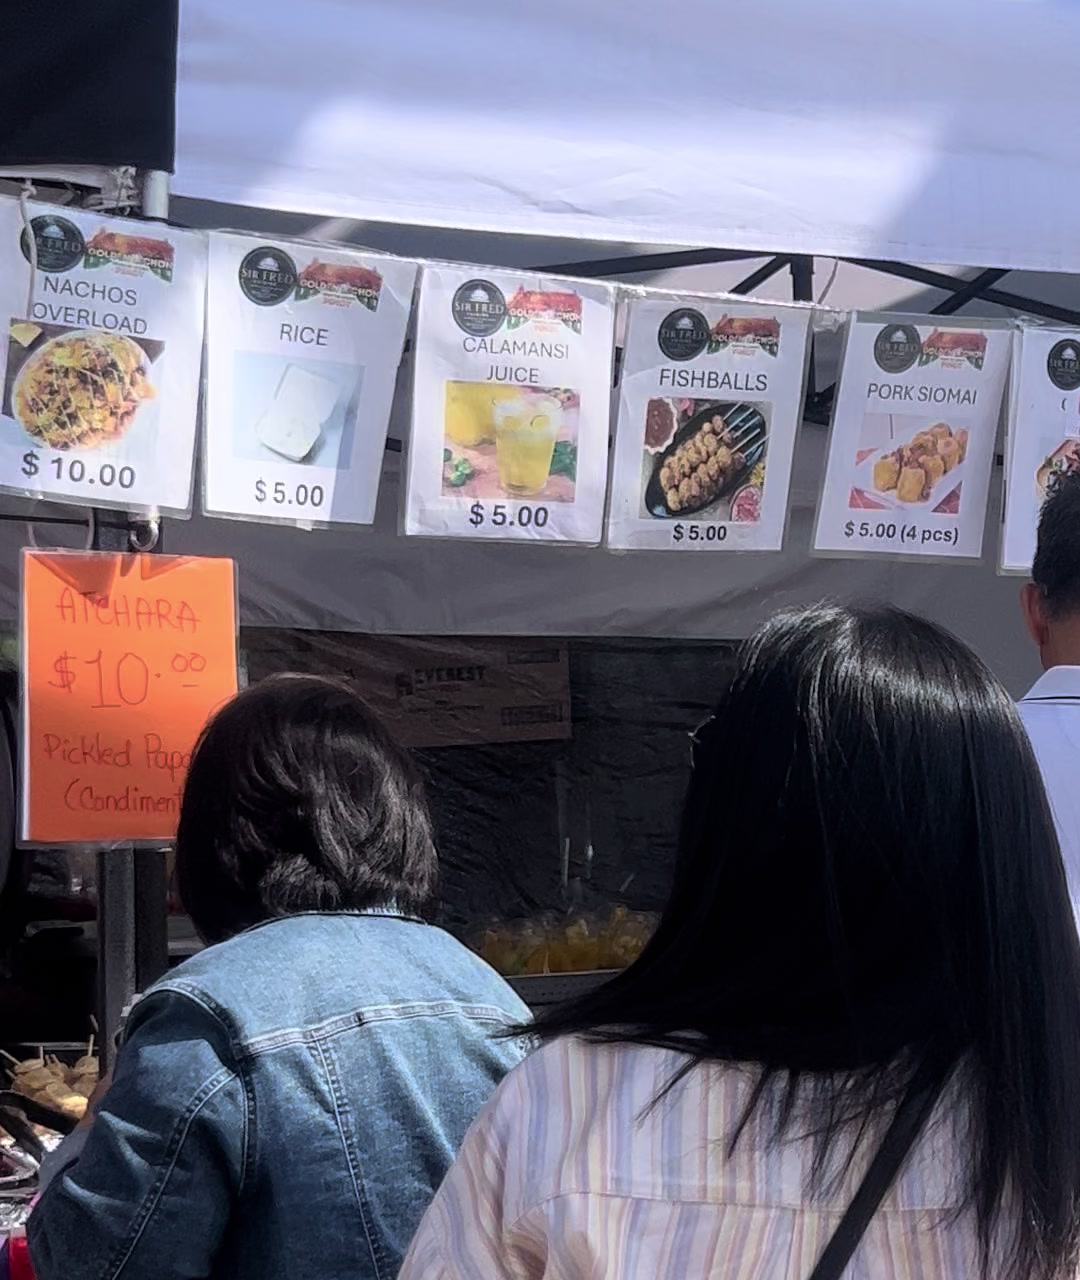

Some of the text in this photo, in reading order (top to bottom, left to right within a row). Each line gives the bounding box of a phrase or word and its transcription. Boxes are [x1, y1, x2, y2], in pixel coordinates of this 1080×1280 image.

[43, 275, 138, 307] NACHOS
[32, 302, 148, 335] OVERLOAD
[279, 322, 330, 347] RICE
[462, 336, 570, 361] CALAMANSI
[486, 365, 541, 385] JUICE
[658, 368, 769, 393] FISHBALLS
[865, 381, 979, 406] PORK SIOMAI
[21, 450, 137, 490] $ 10.00
[254, 477, 325, 508] $ 5.00
[468, 500, 550, 529] $ 5.00
[672, 522, 729, 543] $ 5.00
[843, 520, 960, 546] $ 5.00 (4 pcs)
[56, 586, 201, 634] ATCHARA
[43, 731, 132, 768] Pickled
